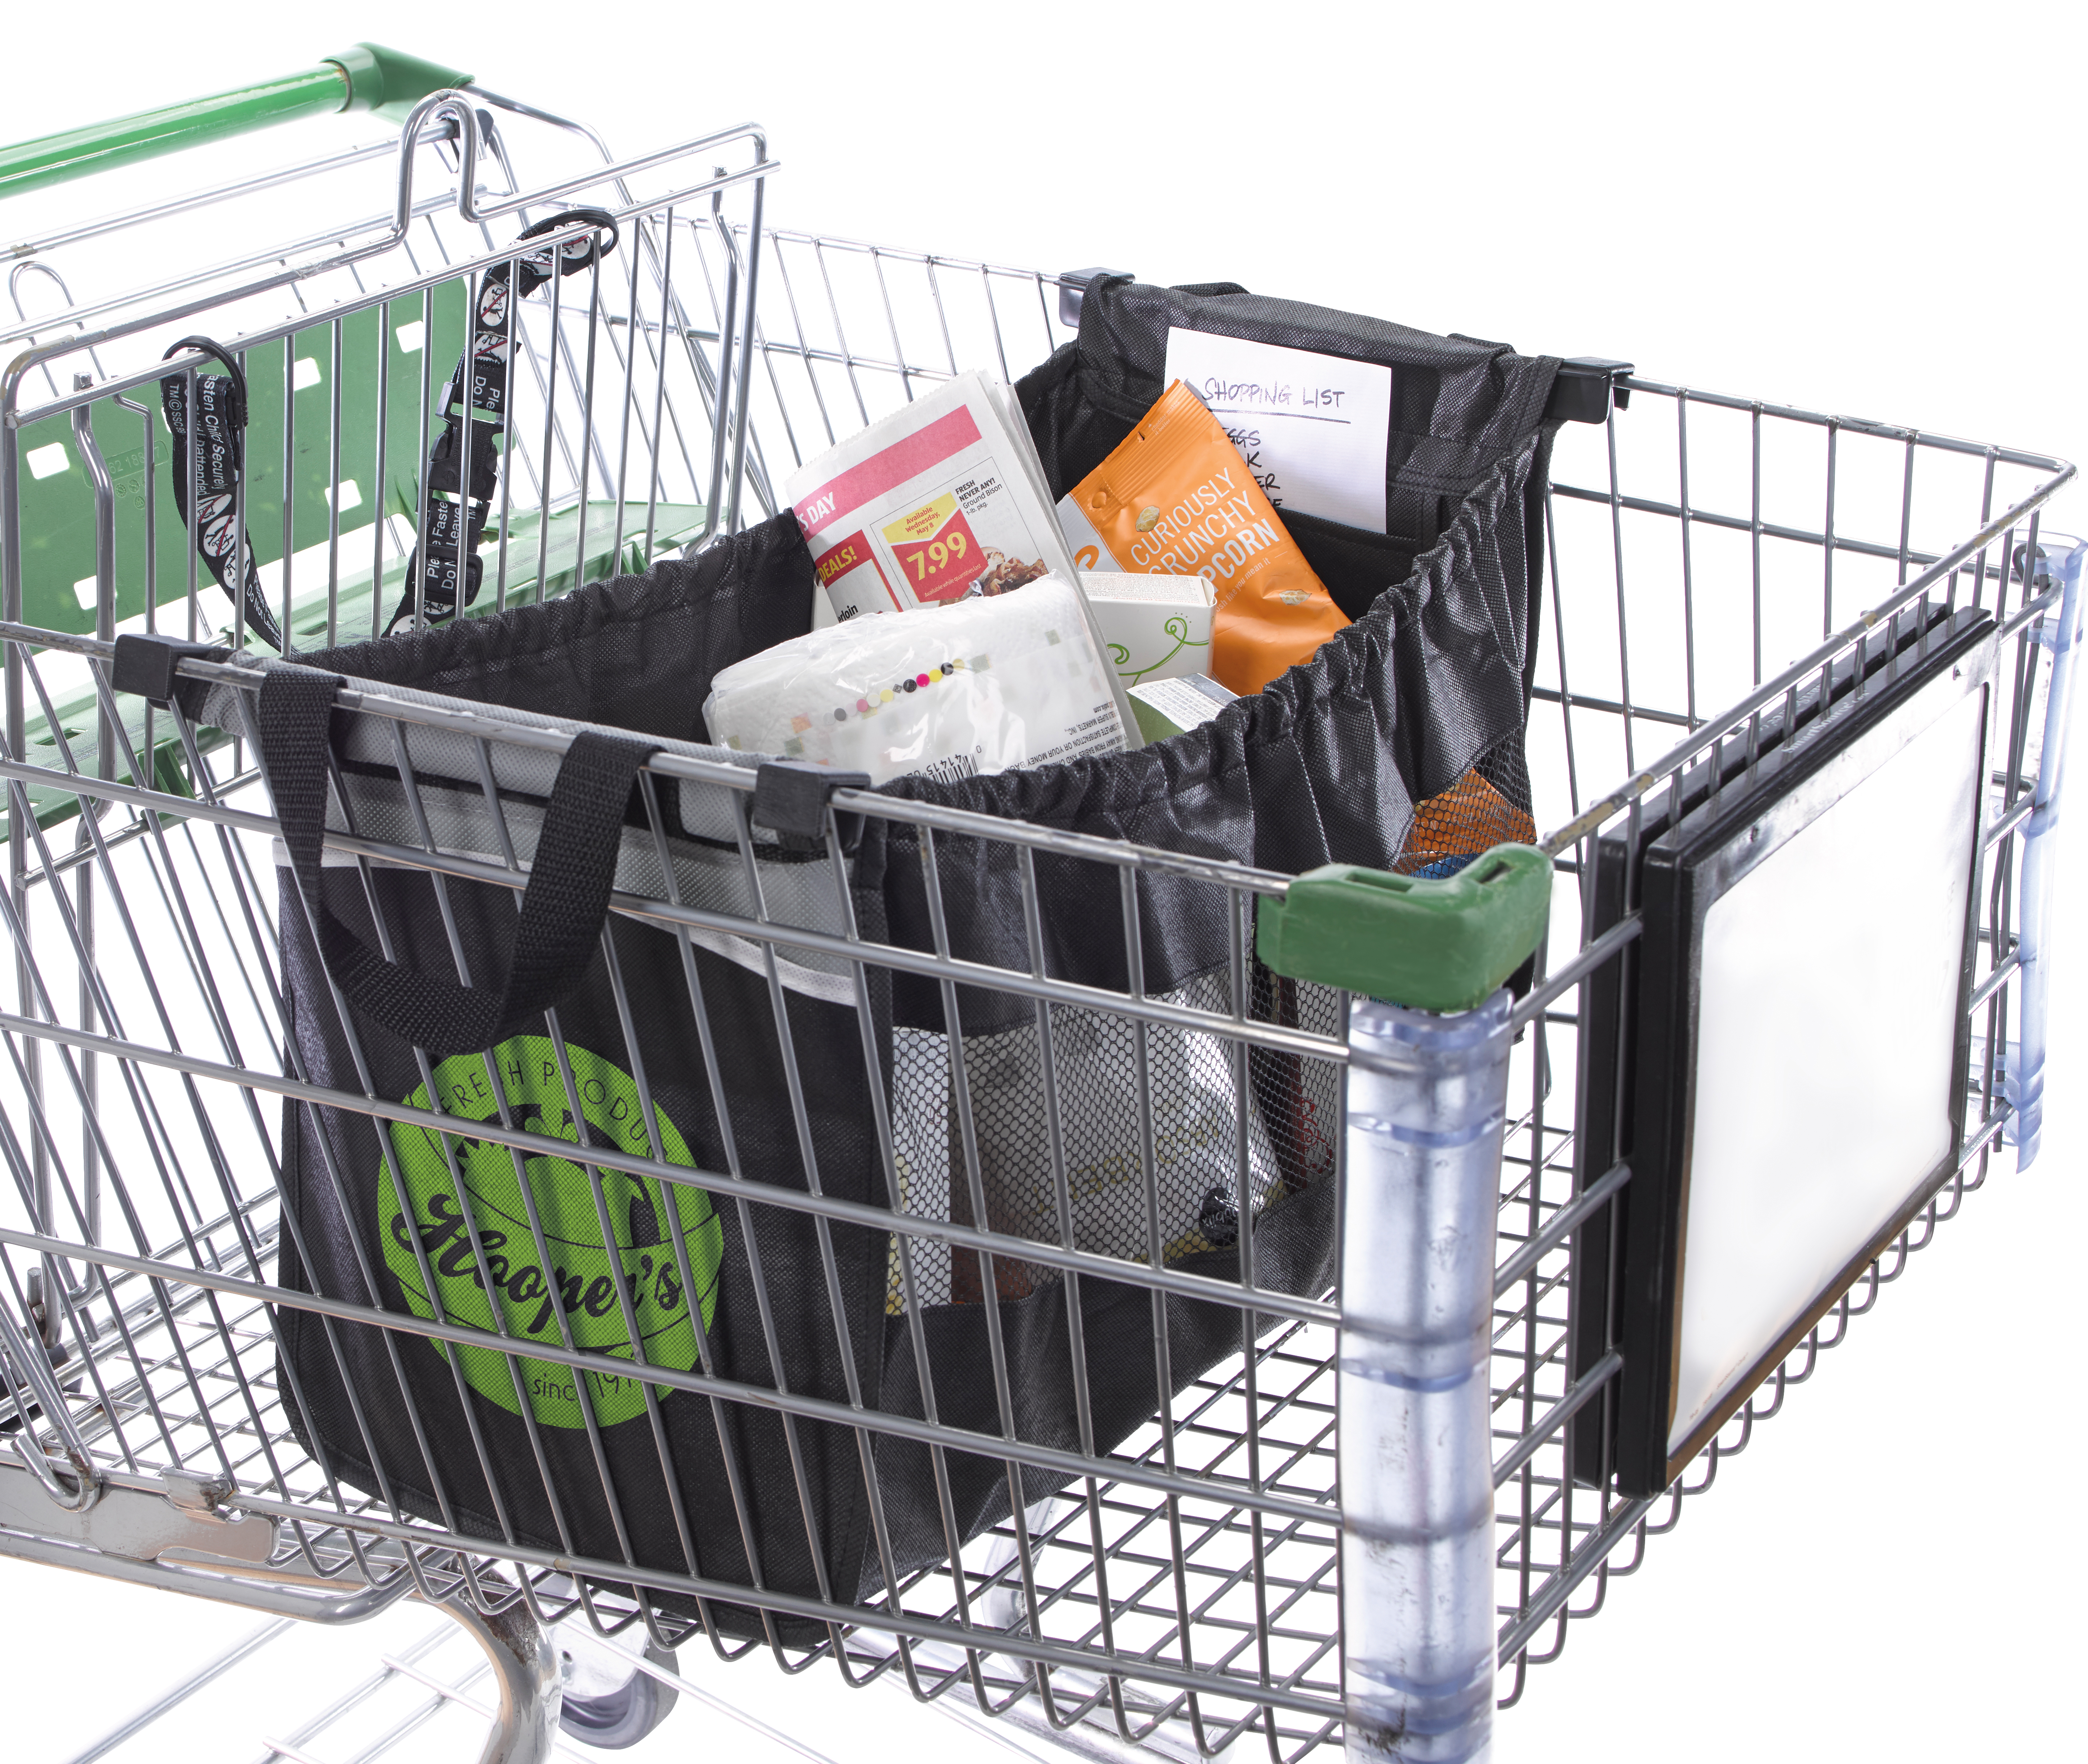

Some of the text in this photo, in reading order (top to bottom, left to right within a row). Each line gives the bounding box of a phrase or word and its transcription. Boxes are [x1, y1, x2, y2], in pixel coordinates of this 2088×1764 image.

[474, 375, 486, 395] Do
[1201, 377, 1345, 408] SHOPPING LIST
[484, 388, 500, 411] Ple
[204, 375, 228, 489] asten Child Securely
[197, 434, 211, 496] nattended
[955, 480, 975, 494] FRESH
[959, 478, 995, 502] NEVER ANY!
[963, 484, 1003, 509] Ground Bison
[432, 499, 448, 537] Faste
[807, 492, 836, 524] DAY
[906, 507, 933, 524] Available
[977, 502, 988, 513] pkg.
[1131, 467, 1235, 566] CURIOUSLY
[446, 507, 460, 547] Leave
[905, 512, 940, 532] Wednesday,
[916, 526, 929, 535] May
[818, 546, 857, 582] DEALS!
[906, 532, 966, 581] 7.99
[1196, 518, 1280, 593] PCORN
[441, 570, 456, 590] Do
[925, 564, 981, 597] Available while quantities last
[1226, 589, 1237, 601] like
[1235, 578, 1245, 591] you
[1245, 562, 1264, 579] mean
[247, 584, 254, 603] Do
[254, 598, 263, 619] Not
[838, 605, 859, 623] erloin
[1076, 718, 1097, 732] MARKETS,
[1096, 713, 1108, 723] SUPER
[1064, 726, 1077, 736] INC.,
[1072, 730, 1101, 747] SATISFACTION
[1101, 723, 1117, 735] COMPLETE
[1047, 745, 1063, 758] YOUR
[1063, 742, 1072, 750] OR
[1078, 747, 1094, 758] BABIES
[1094, 742, 1105, 752] FROM
[1105, 737, 1116, 747] AWAY
[926, 753, 962, 775] 41415
[1026, 752, 1047, 766] MONEY
[1066, 754, 1077, 763] AND
[440, 1060, 668, 1159] FREH PODU
[390, 1193, 682, 1334] Hooper's
[532, 1373, 579, 1402] sinc
